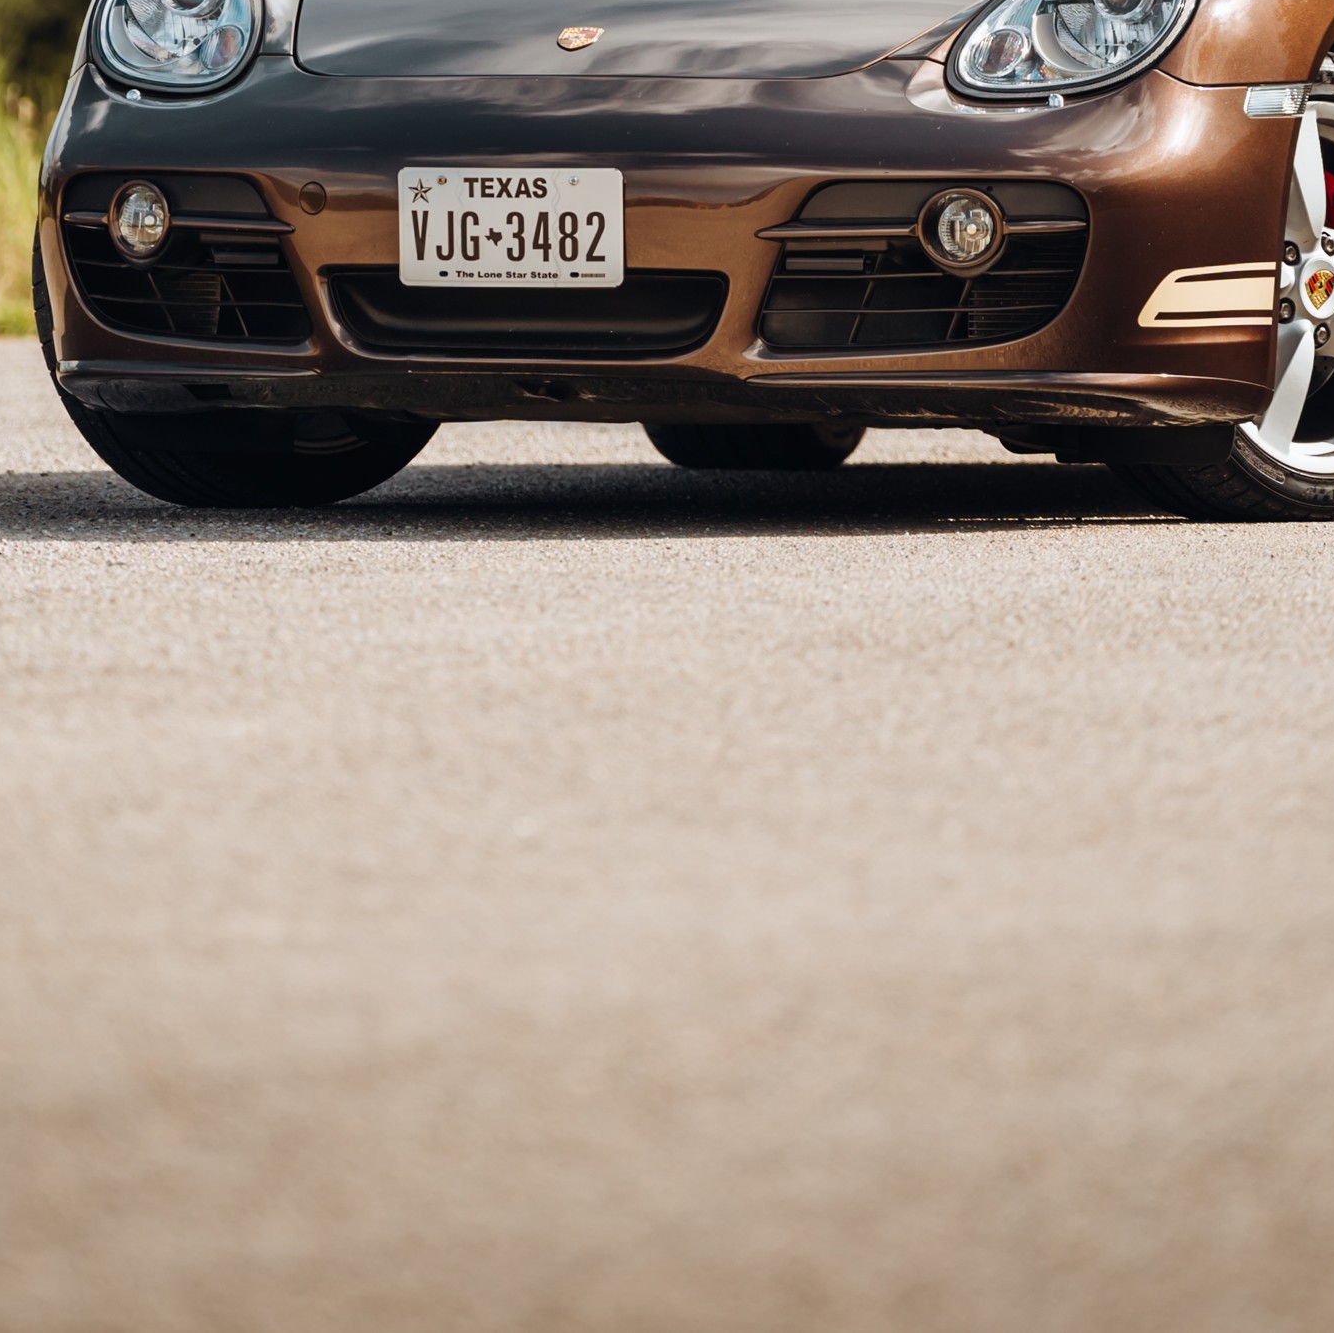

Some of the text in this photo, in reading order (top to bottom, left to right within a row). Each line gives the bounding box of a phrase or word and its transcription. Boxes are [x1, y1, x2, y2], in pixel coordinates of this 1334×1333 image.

[463, 177, 548, 199] TEXAS
[411, 210, 606, 263] VJG 3482
[455, 270, 559, 279] The Lone Star State
